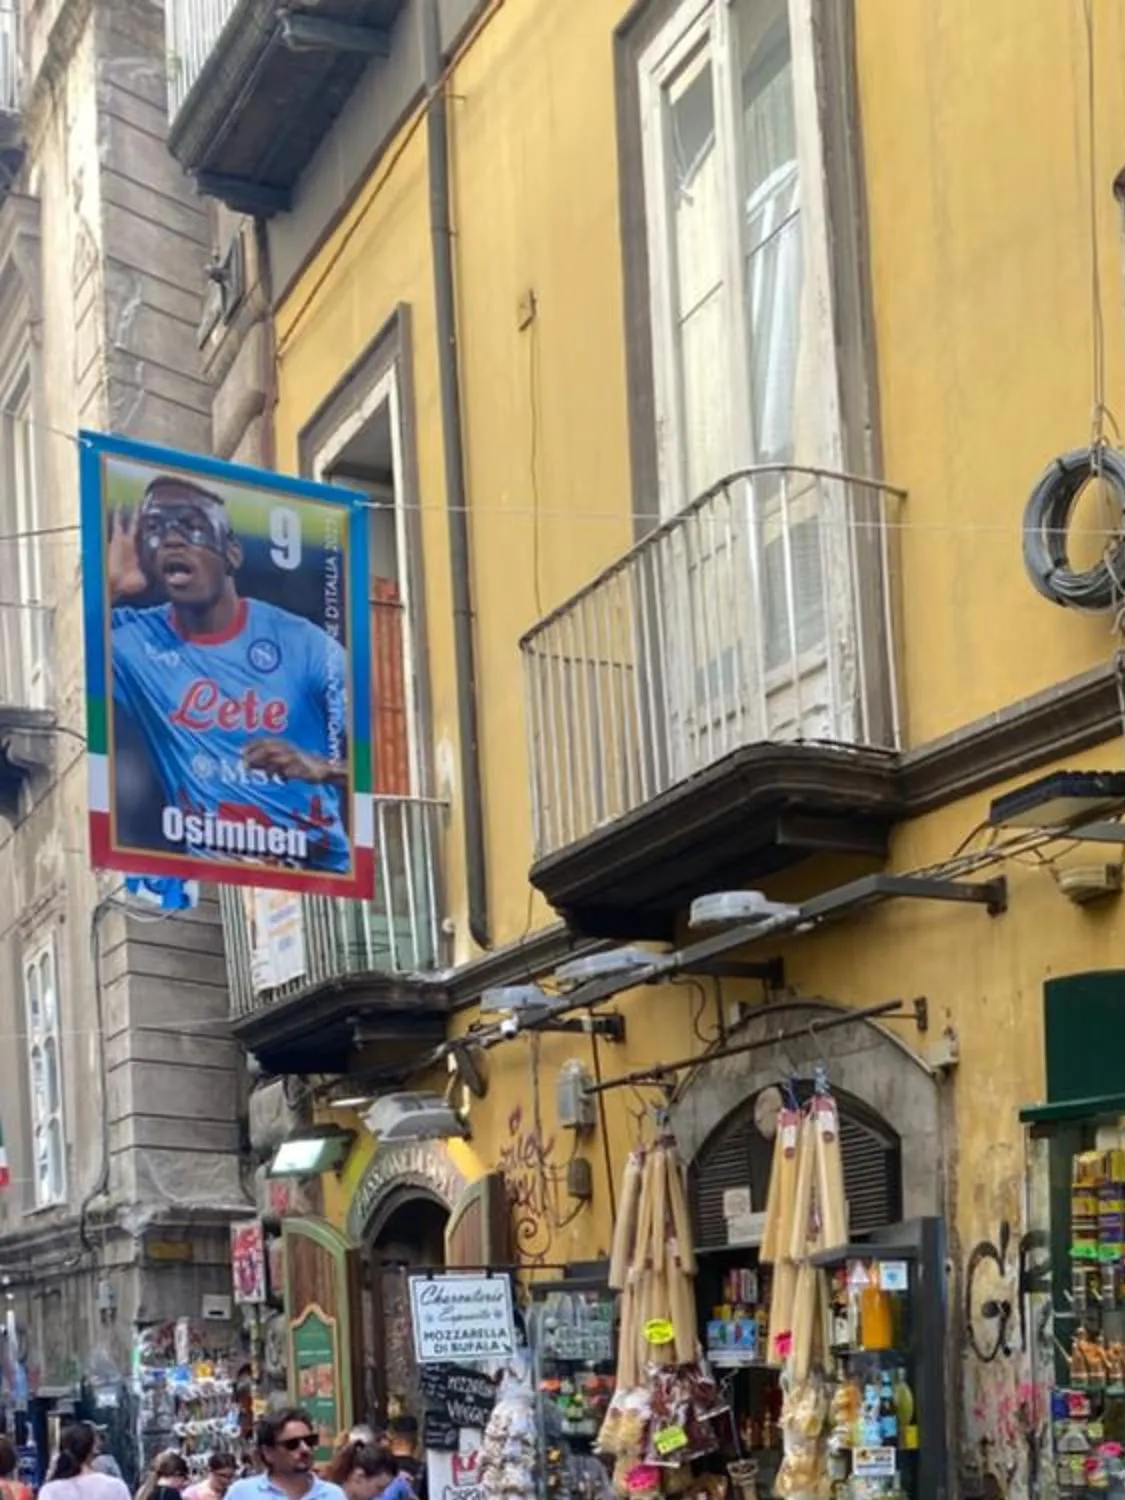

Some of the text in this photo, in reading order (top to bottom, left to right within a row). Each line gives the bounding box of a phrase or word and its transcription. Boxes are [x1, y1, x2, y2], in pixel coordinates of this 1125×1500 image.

[269, 506, 302, 570] 9
[170, 679, 289, 733] Lete
[161, 805, 309, 857] Osimhen
[423, 1327, 507, 1341] MOZZARELLA
[433, 1341, 500, 1354] DI BUFALA
